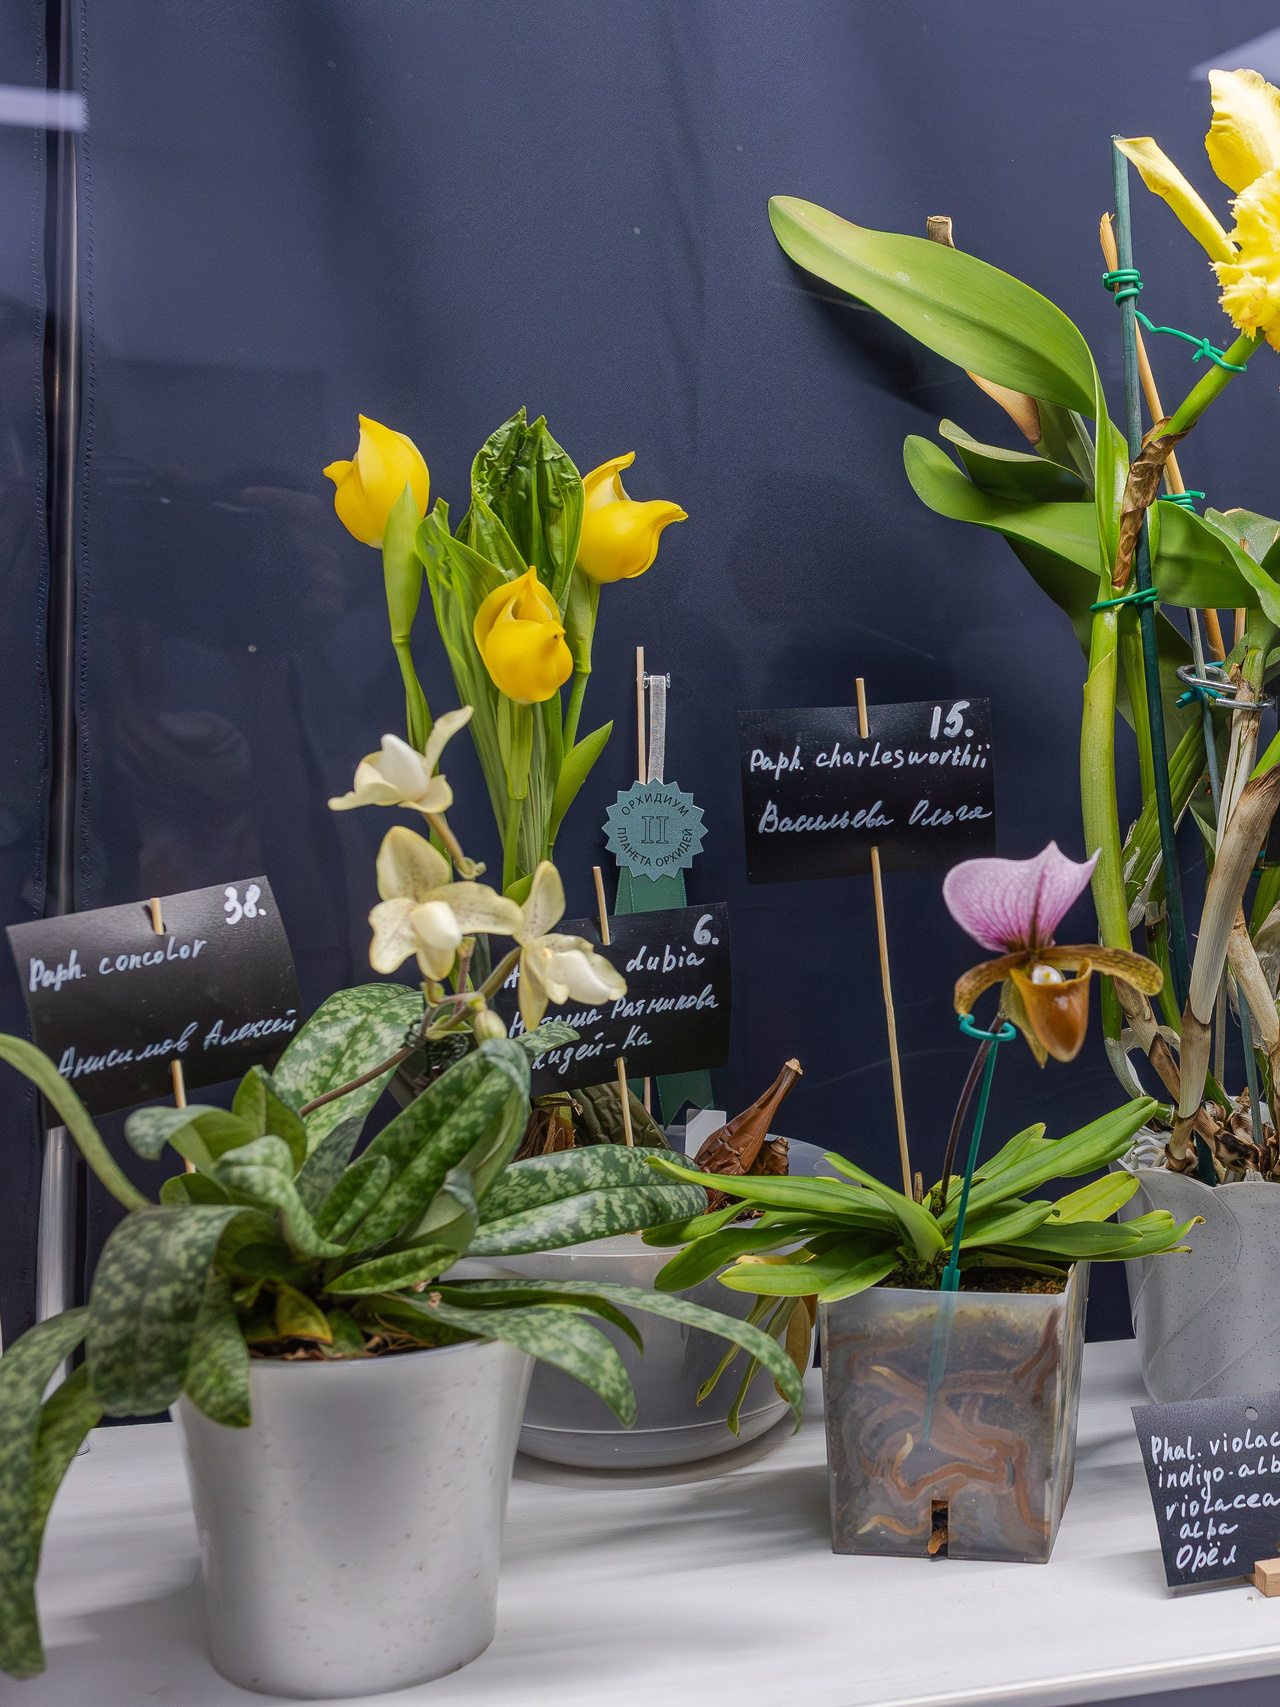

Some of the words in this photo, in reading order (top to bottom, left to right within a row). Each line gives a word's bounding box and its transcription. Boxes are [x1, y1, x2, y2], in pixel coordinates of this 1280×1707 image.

[929, 700, 974, 740] 15.
[750, 745, 804, 780] Paph.
[815, 742, 991, 769] charlesworthii
[621, 792, 690, 817] ОРХИДИУМ
[758, 800, 895, 834] Васильева
[908, 799, 993, 827] Ольга
[617, 827, 652, 867] ПЛАНЕТА
[655, 828, 694, 867] ОРХИДЕЙ
[641, 815, 670, 845] II
[223, 883, 268, 925] 38.
[693, 913, 720, 946] 6.
[28, 949, 87, 992] Paph.
[99, 936, 207, 975] concolor
[625, 945, 706, 973] dubia
[58, 1021, 199, 1080] Анисимов
[203, 1008, 297, 1050] Алексей
[1150, 1435, 1202, 1465] Phal.
[1179, 1517, 1239, 1540] alba
[1175, 1541, 1237, 1573] Орёл
